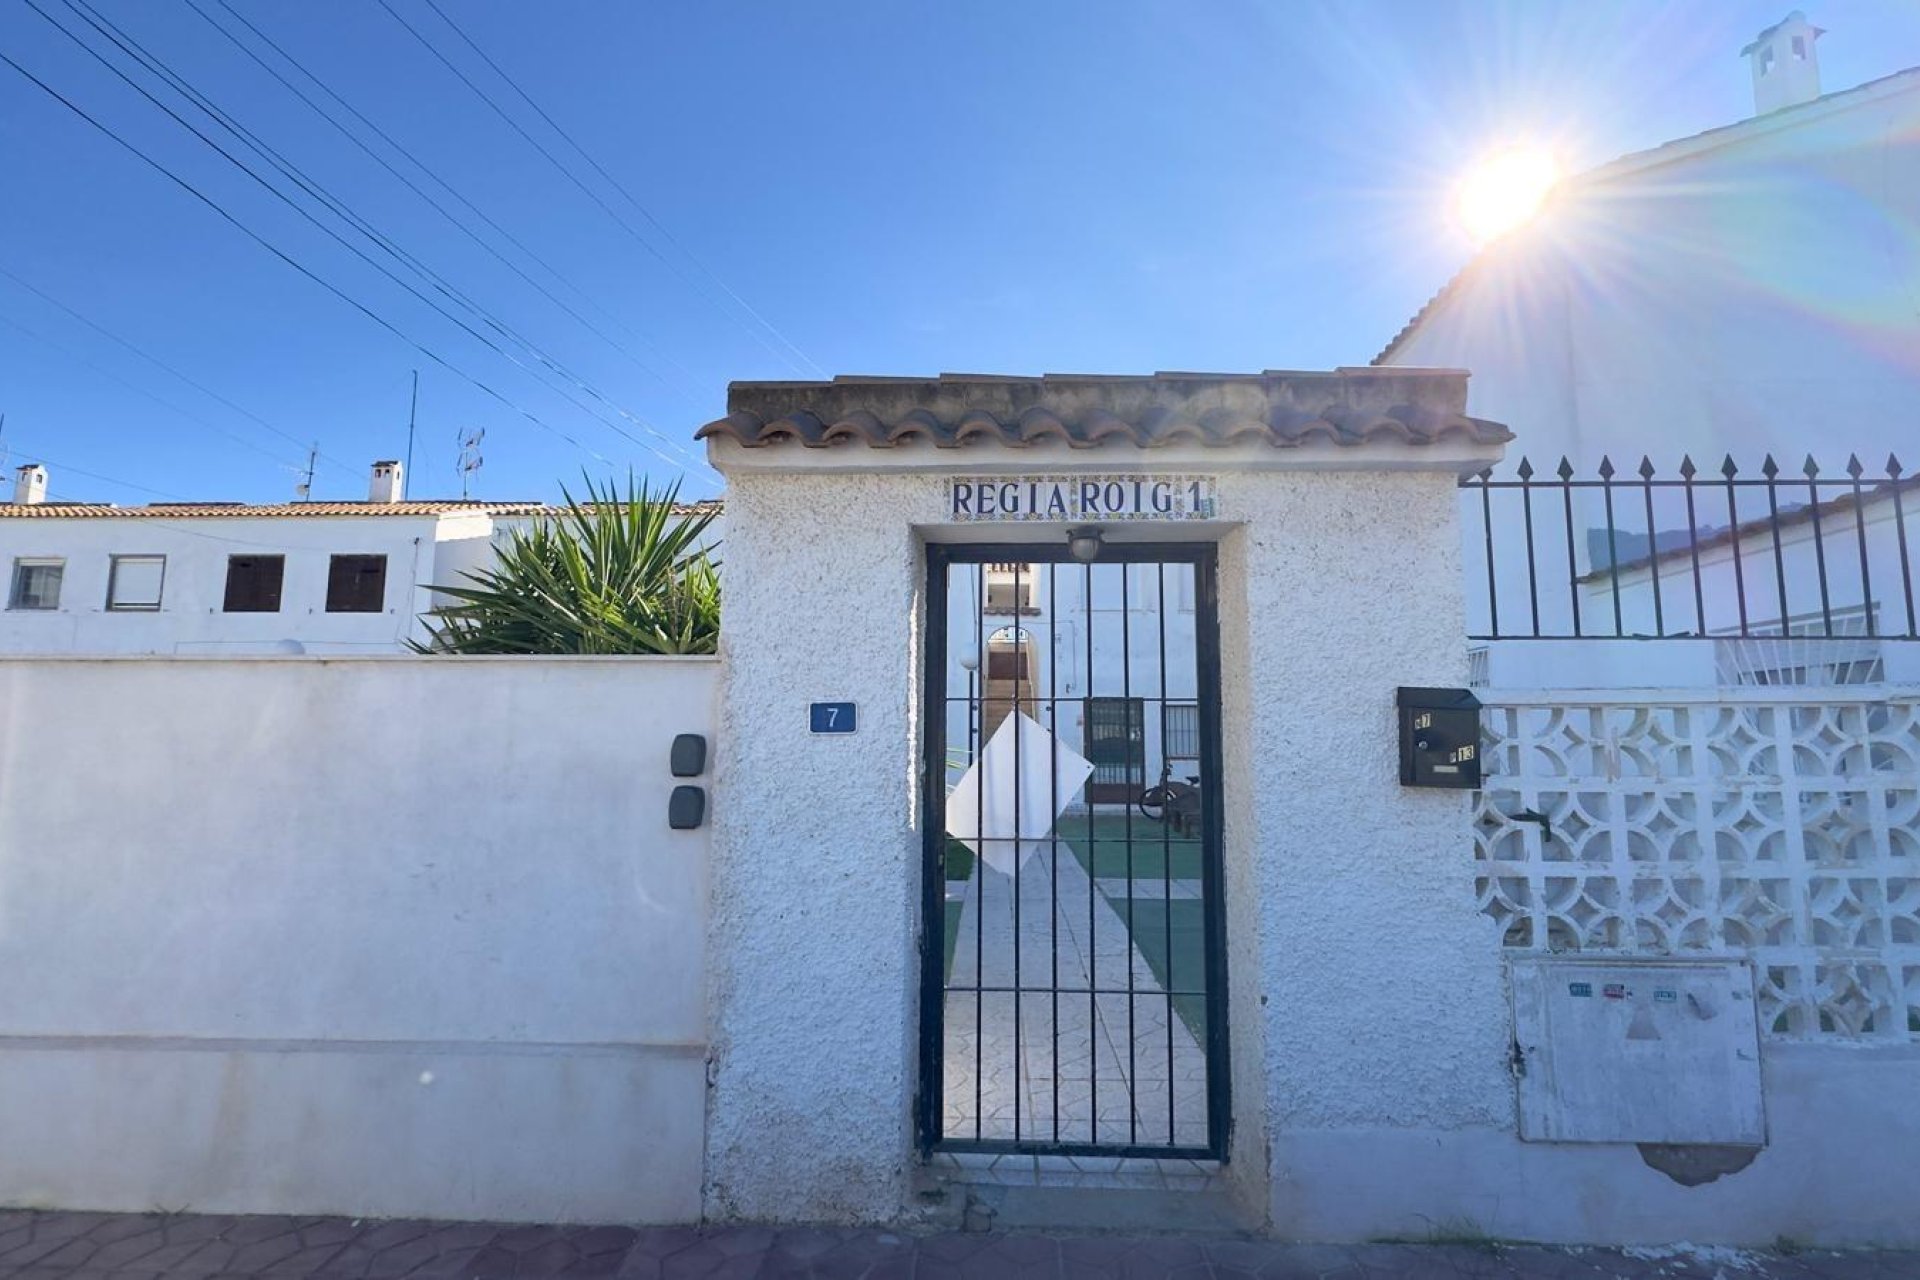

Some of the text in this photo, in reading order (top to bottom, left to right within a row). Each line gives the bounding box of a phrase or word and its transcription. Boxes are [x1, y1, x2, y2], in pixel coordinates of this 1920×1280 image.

[953, 482, 1200, 514] REGIA ROIG 1
[827, 708, 839, 727] 7
